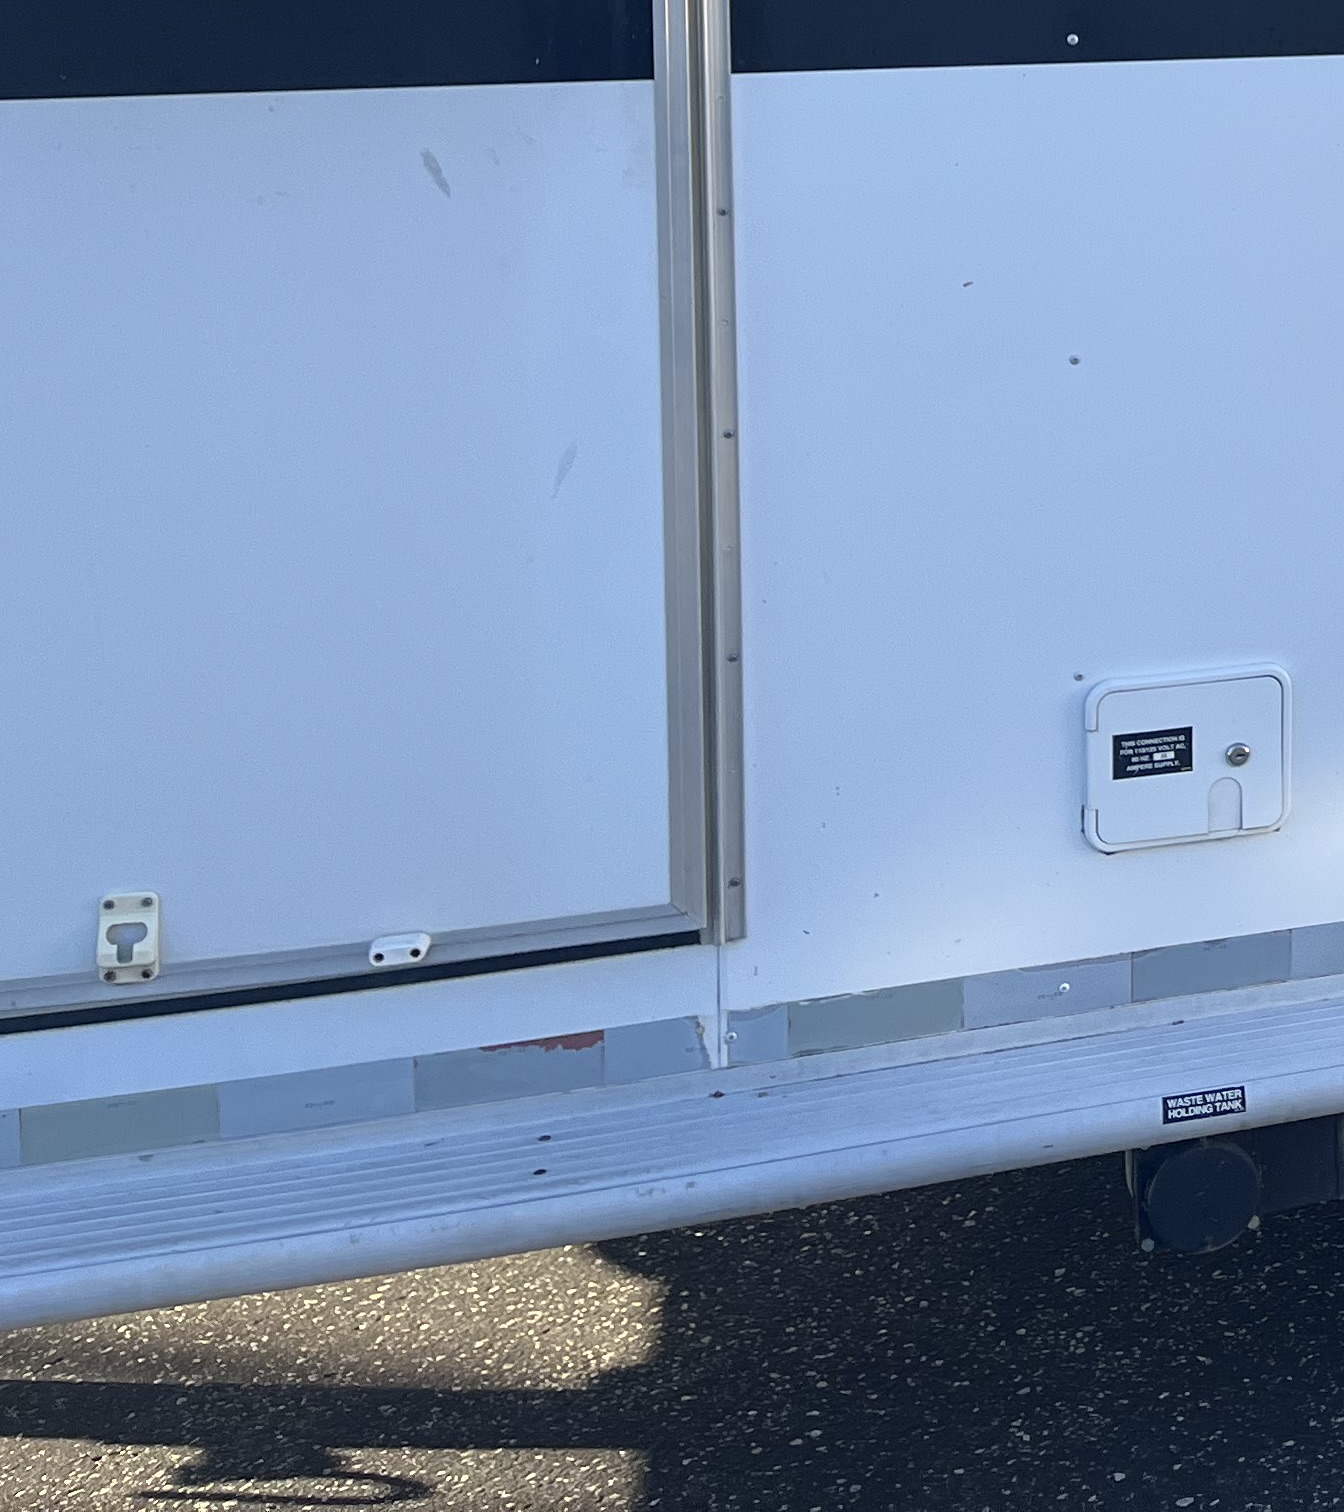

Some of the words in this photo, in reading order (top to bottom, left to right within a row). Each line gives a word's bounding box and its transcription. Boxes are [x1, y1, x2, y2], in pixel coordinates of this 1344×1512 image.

[1136, 736, 1178, 746] CONNECTION
[1166, 1096, 1204, 1109] WASTE
[1204, 1089, 1242, 1103] WATER
[1167, 1103, 1214, 1119] HOLDING
[1214, 1099, 1242, 1112] TANK
